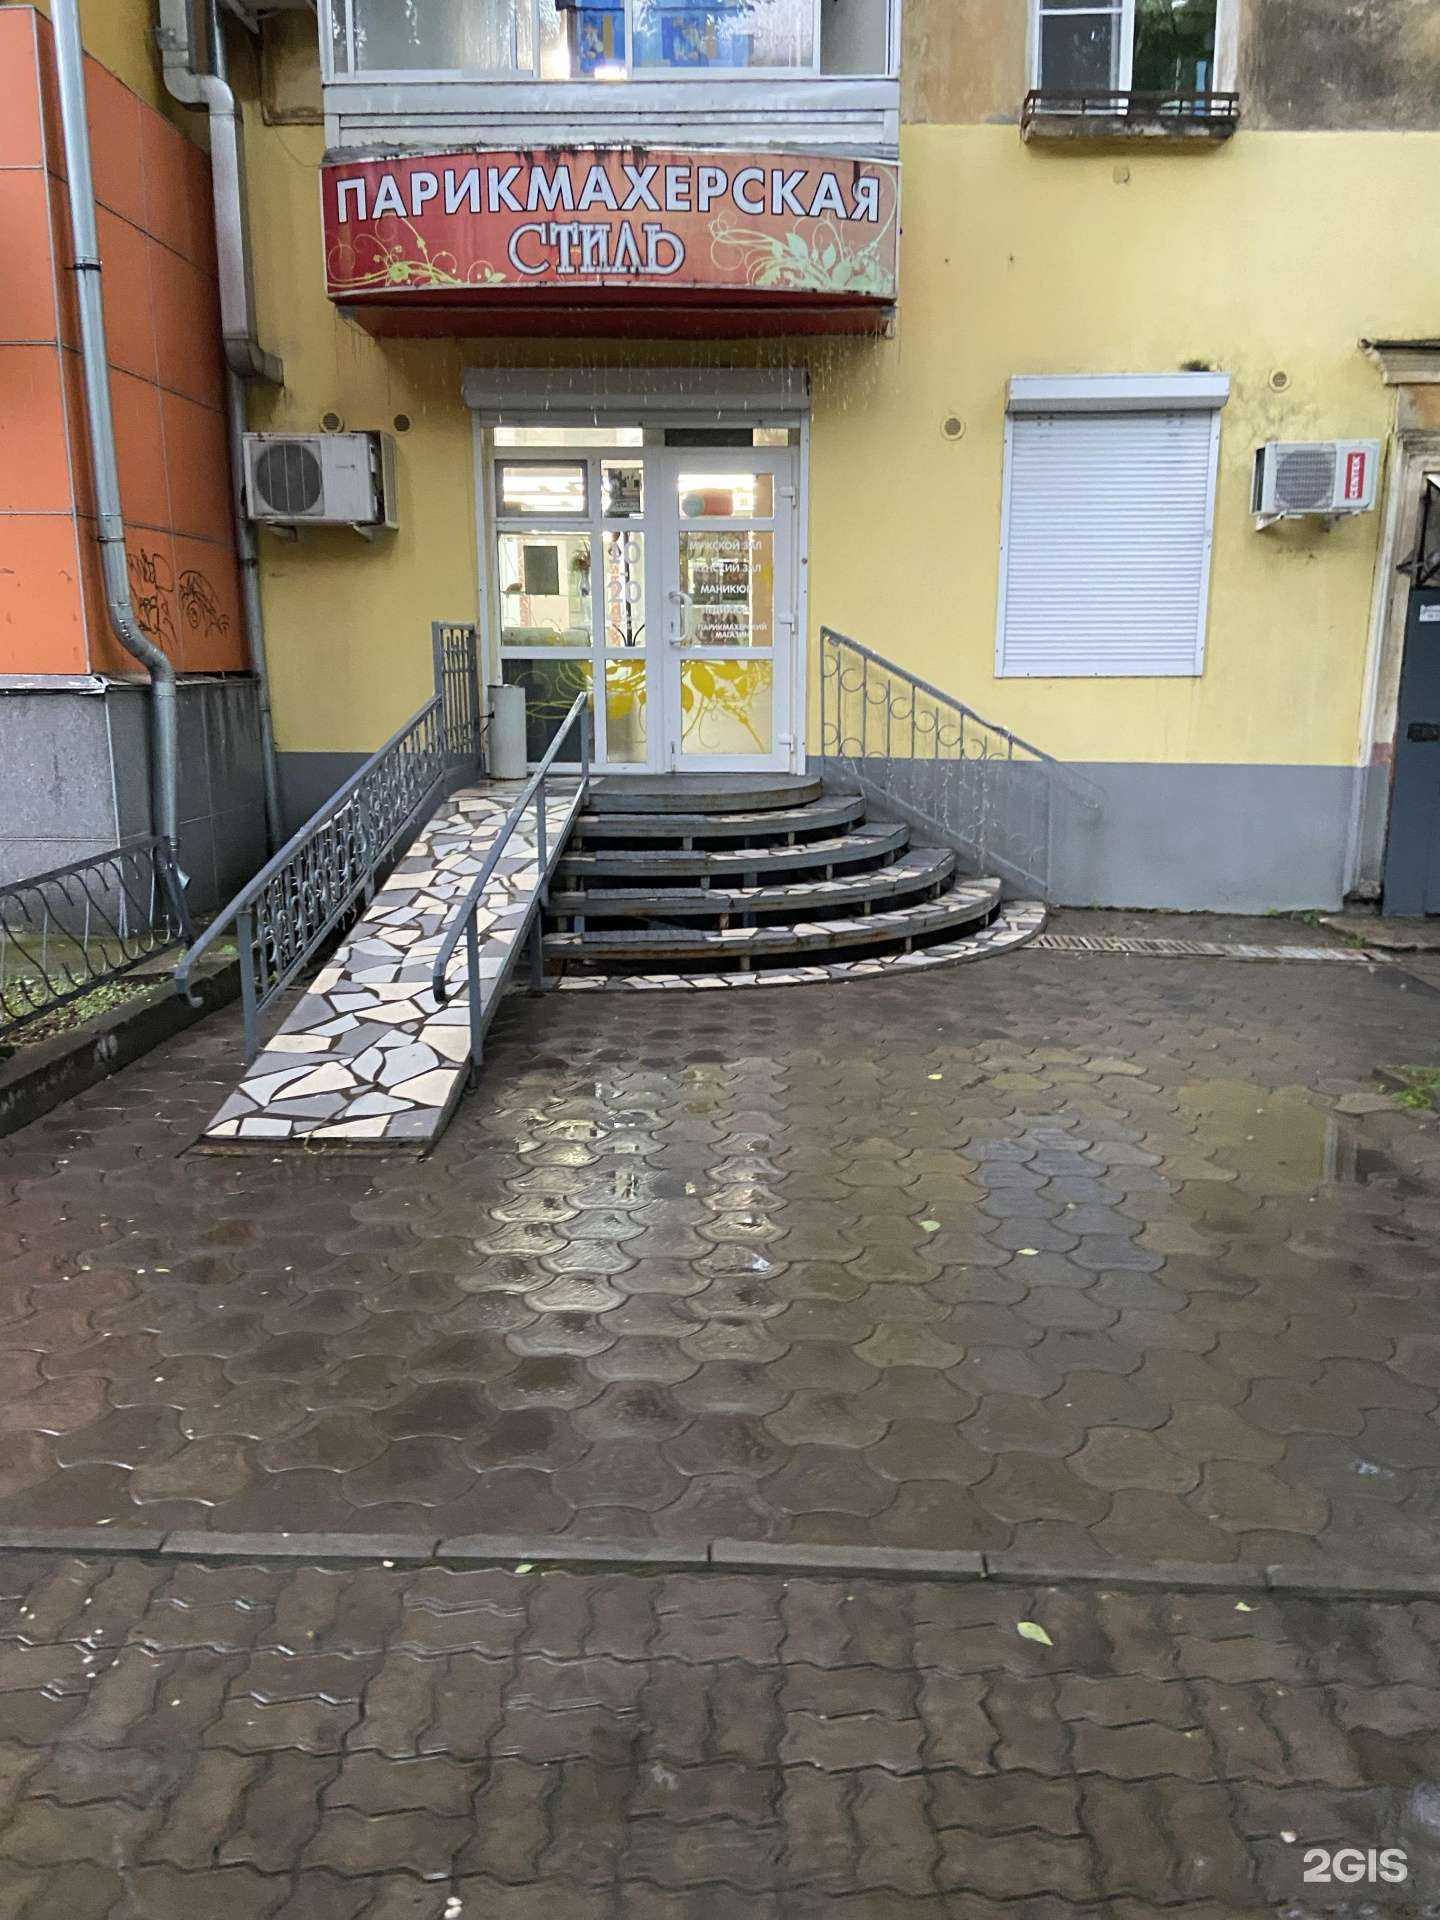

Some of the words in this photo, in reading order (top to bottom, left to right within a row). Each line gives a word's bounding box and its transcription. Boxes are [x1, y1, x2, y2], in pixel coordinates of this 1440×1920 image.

[336, 165, 881, 223] ПАРИКМАХЕРСКАЯ
[507, 221, 685, 275] СТИЛЬ
[608, 580, 642, 603] 20
